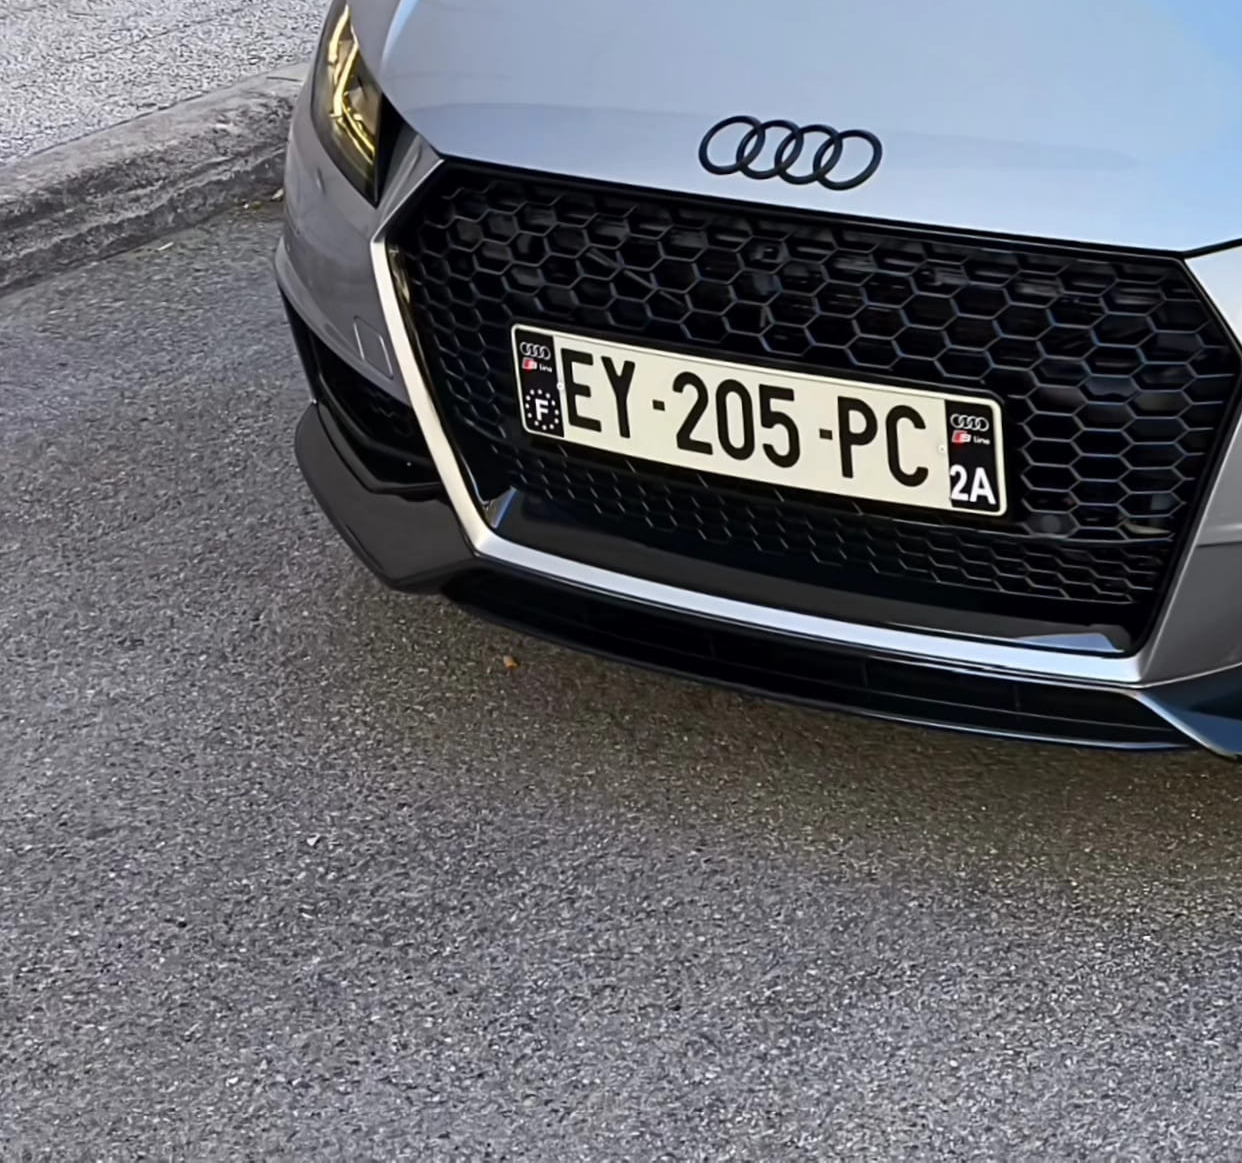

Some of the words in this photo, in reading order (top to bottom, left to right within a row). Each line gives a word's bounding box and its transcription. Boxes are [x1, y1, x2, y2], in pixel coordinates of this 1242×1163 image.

[535, 398, 549, 421] F
[560, 347, 929, 488] EY-205-PC
[950, 464, 997, 505] 2A
